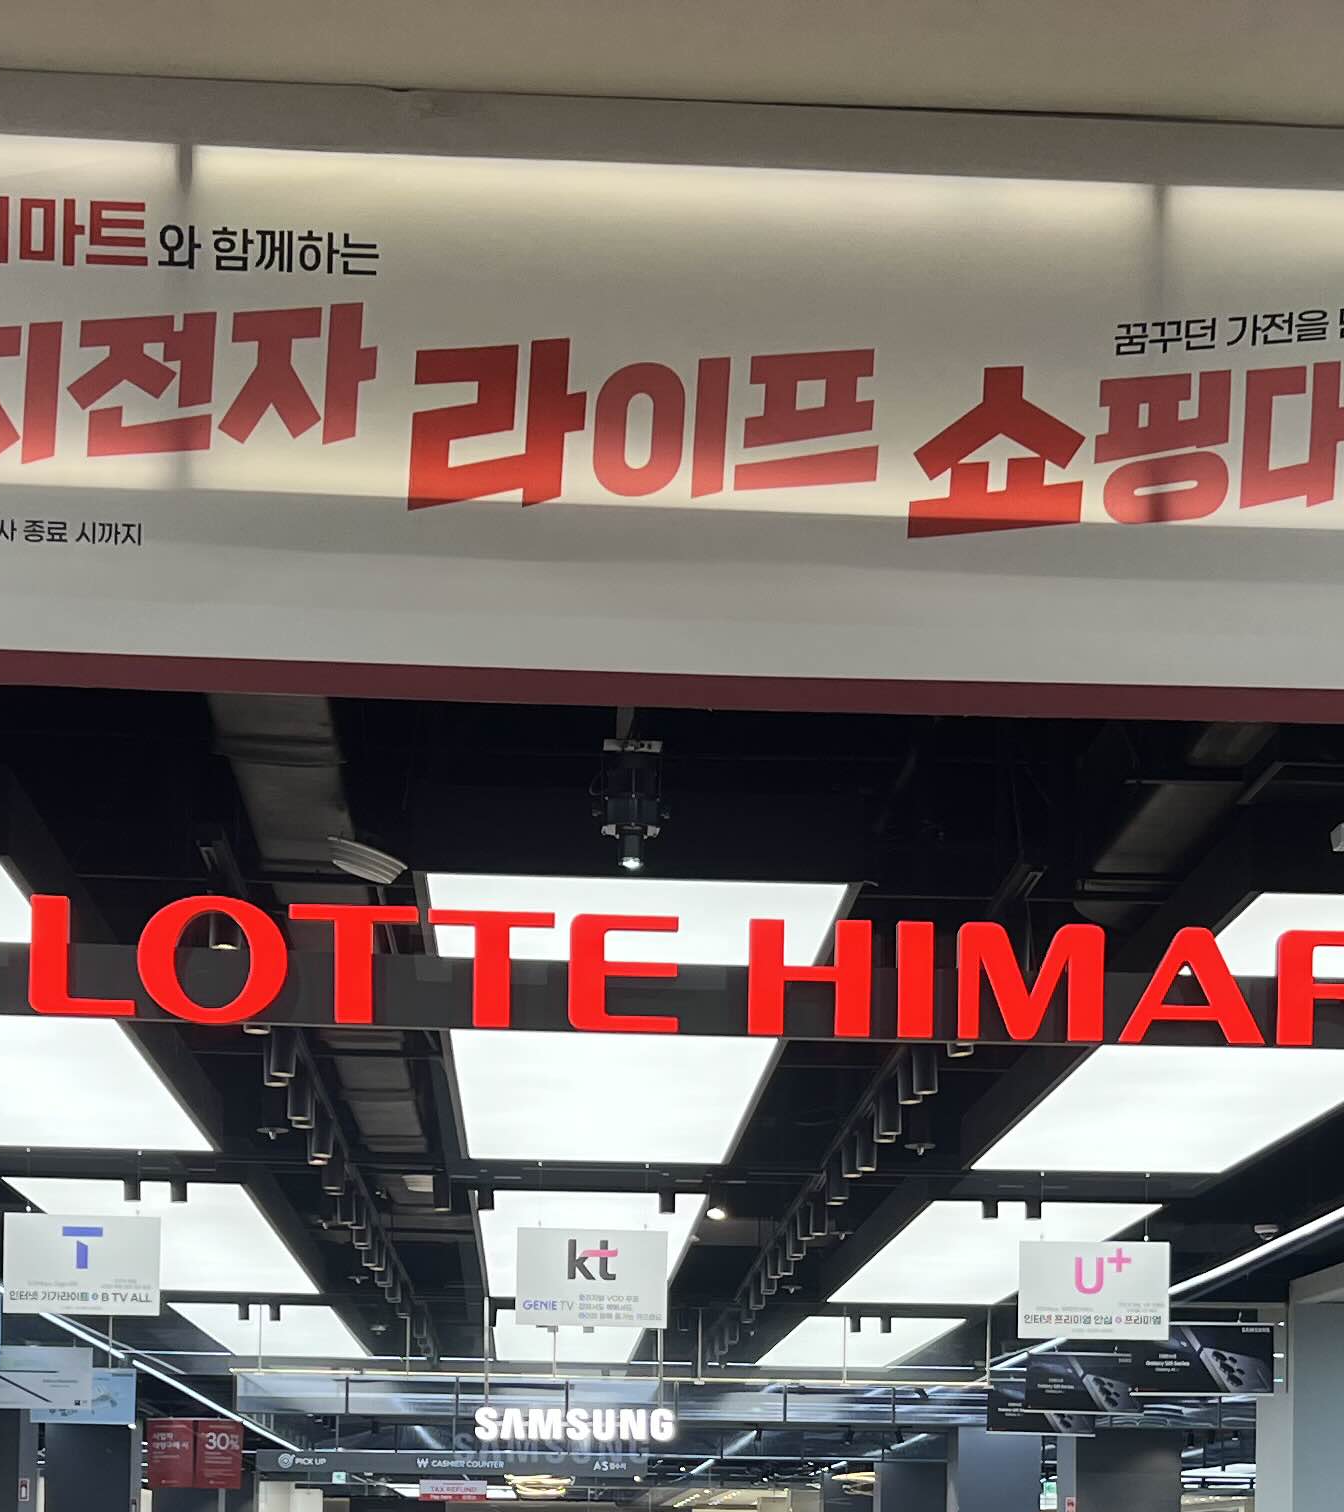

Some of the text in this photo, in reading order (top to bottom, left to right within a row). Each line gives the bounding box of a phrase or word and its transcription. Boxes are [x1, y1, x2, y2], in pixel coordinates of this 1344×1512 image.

[213, 226, 381, 277] 함께하는
[1113, 315, 1220, 357] 꿈꾸던
[1227, 308, 1331, 348] 가전을
[408, 338, 879, 511] 라이프
[23, 520, 68, 545] 종료
[76, 520, 143, 547] 시까지
[26, 893, 681, 1037] LOTTE
[567, 1238, 618, 1281] kt
[1074, 1248, 1132, 1295] U+
[112, 1292, 128, 1303] TV
[131, 1293, 153, 1303] ALL
[523, 1300, 575, 1311] GENIE TV
[474, 1406, 676, 1442] SAMSUNG
[295, 1456, 327, 1465] PICK UP
[466, 1460, 505, 1468] COUNTER
